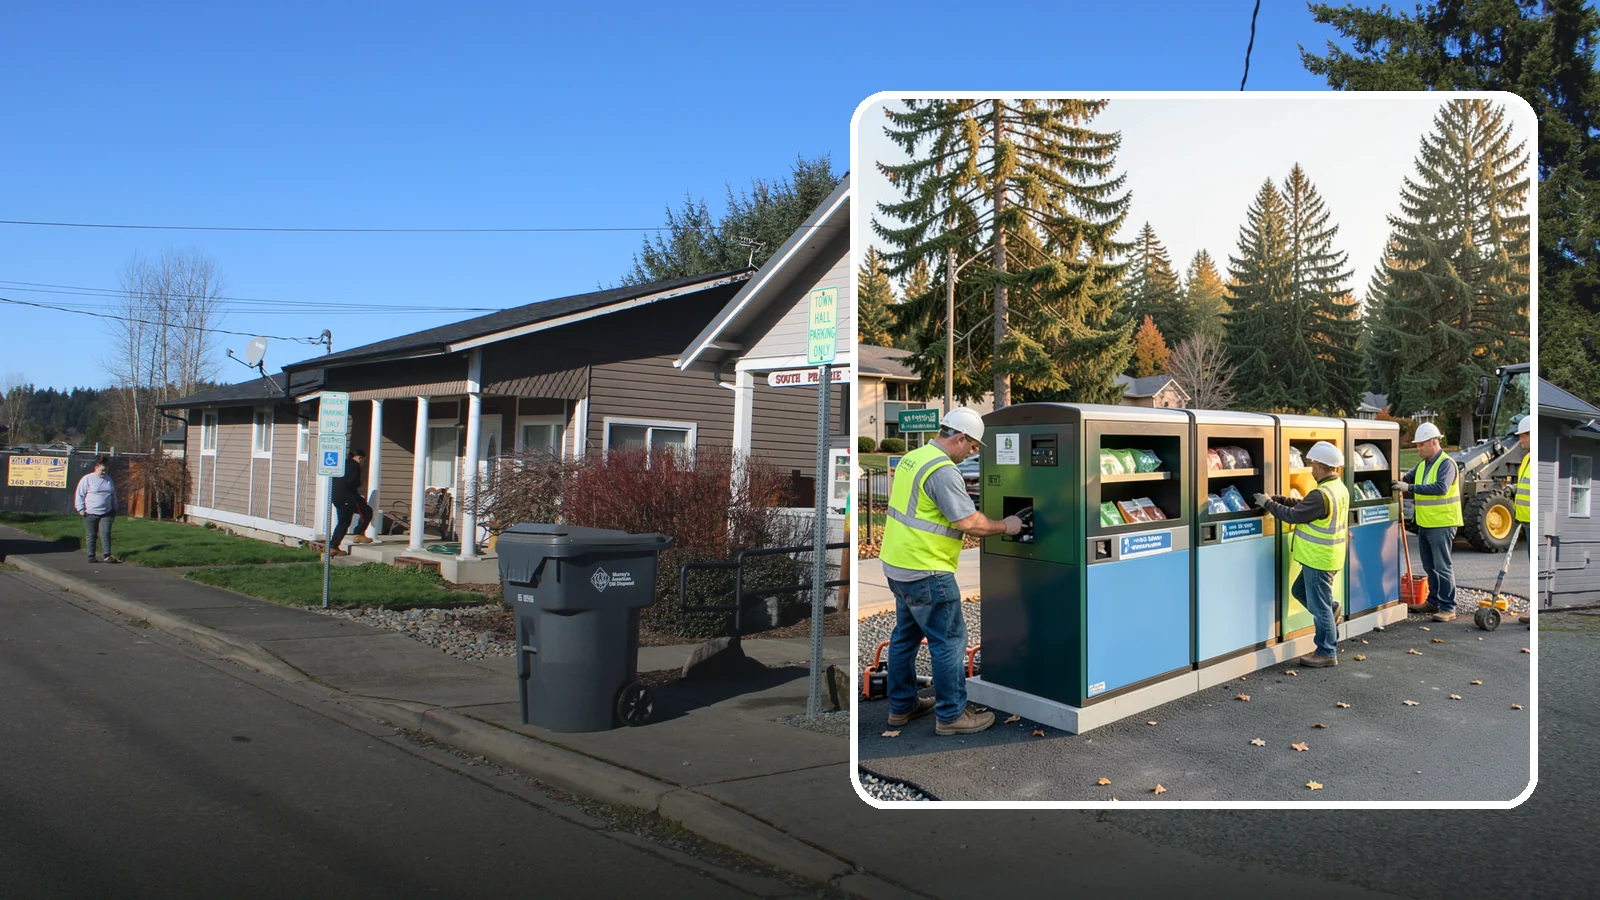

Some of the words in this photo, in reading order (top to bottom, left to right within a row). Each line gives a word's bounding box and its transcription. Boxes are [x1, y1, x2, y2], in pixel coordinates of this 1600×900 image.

[815, 294, 833, 308] TOWN
[814, 311, 831, 324] HALL
[810, 326, 836, 340] PARKING
[813, 344, 831, 357] ONLY
[775, 373, 801, 384] SOUTH
[323, 409, 344, 417] PARKING
[325, 420, 340, 428] ONLY
